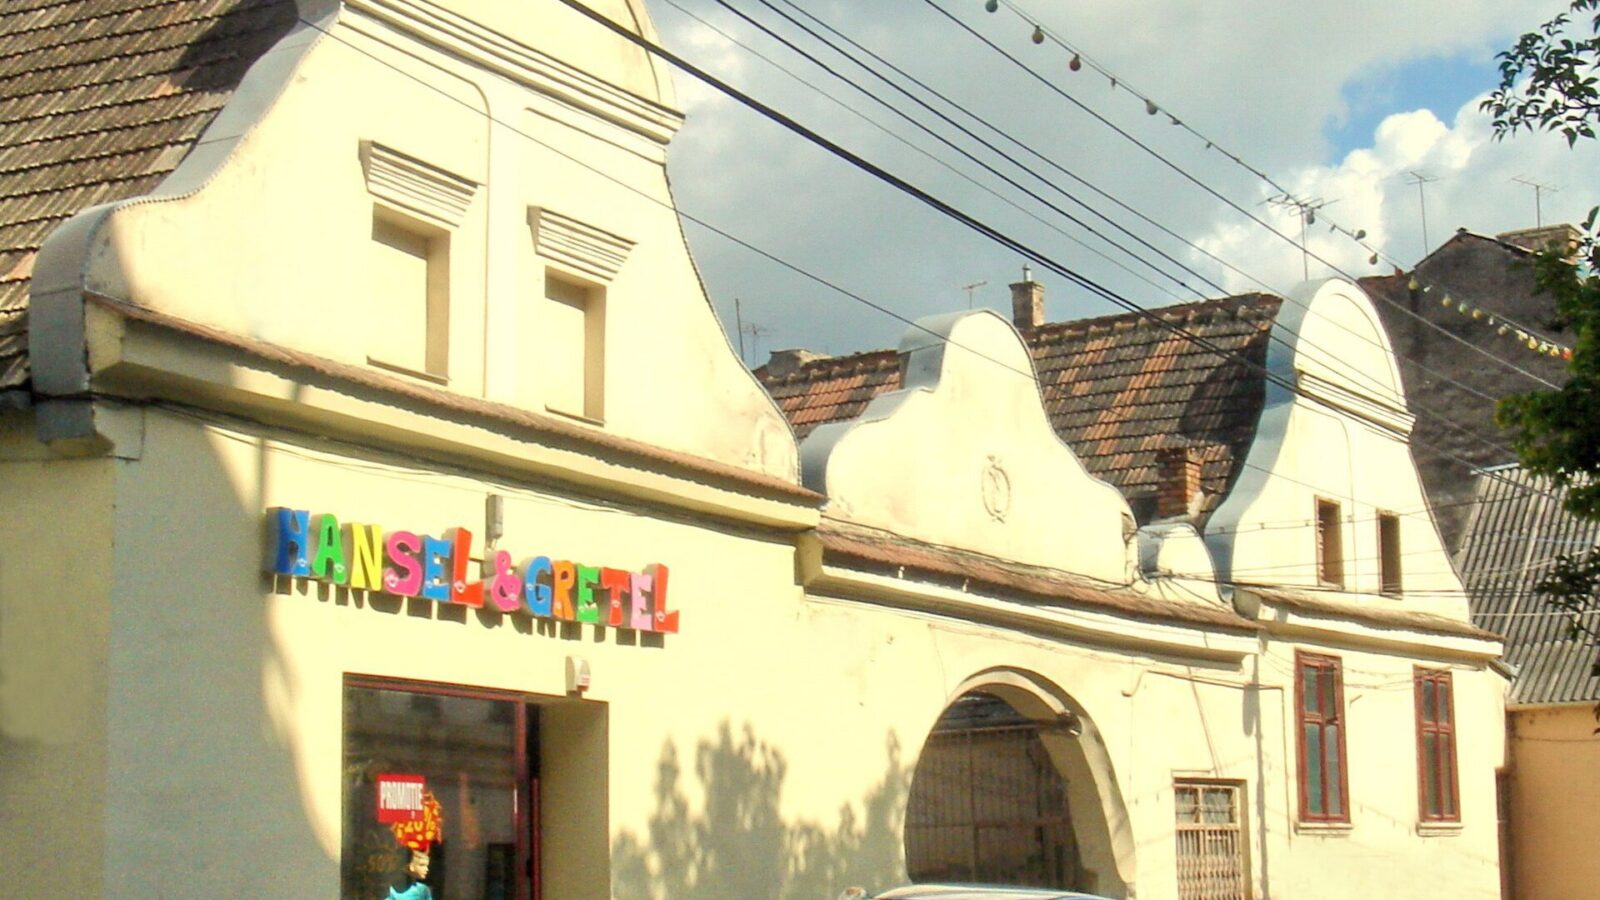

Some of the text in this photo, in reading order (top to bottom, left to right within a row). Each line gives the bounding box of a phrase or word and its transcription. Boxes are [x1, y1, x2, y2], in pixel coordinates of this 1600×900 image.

[267, 507, 680, 634] HANSEL & GRETEL
